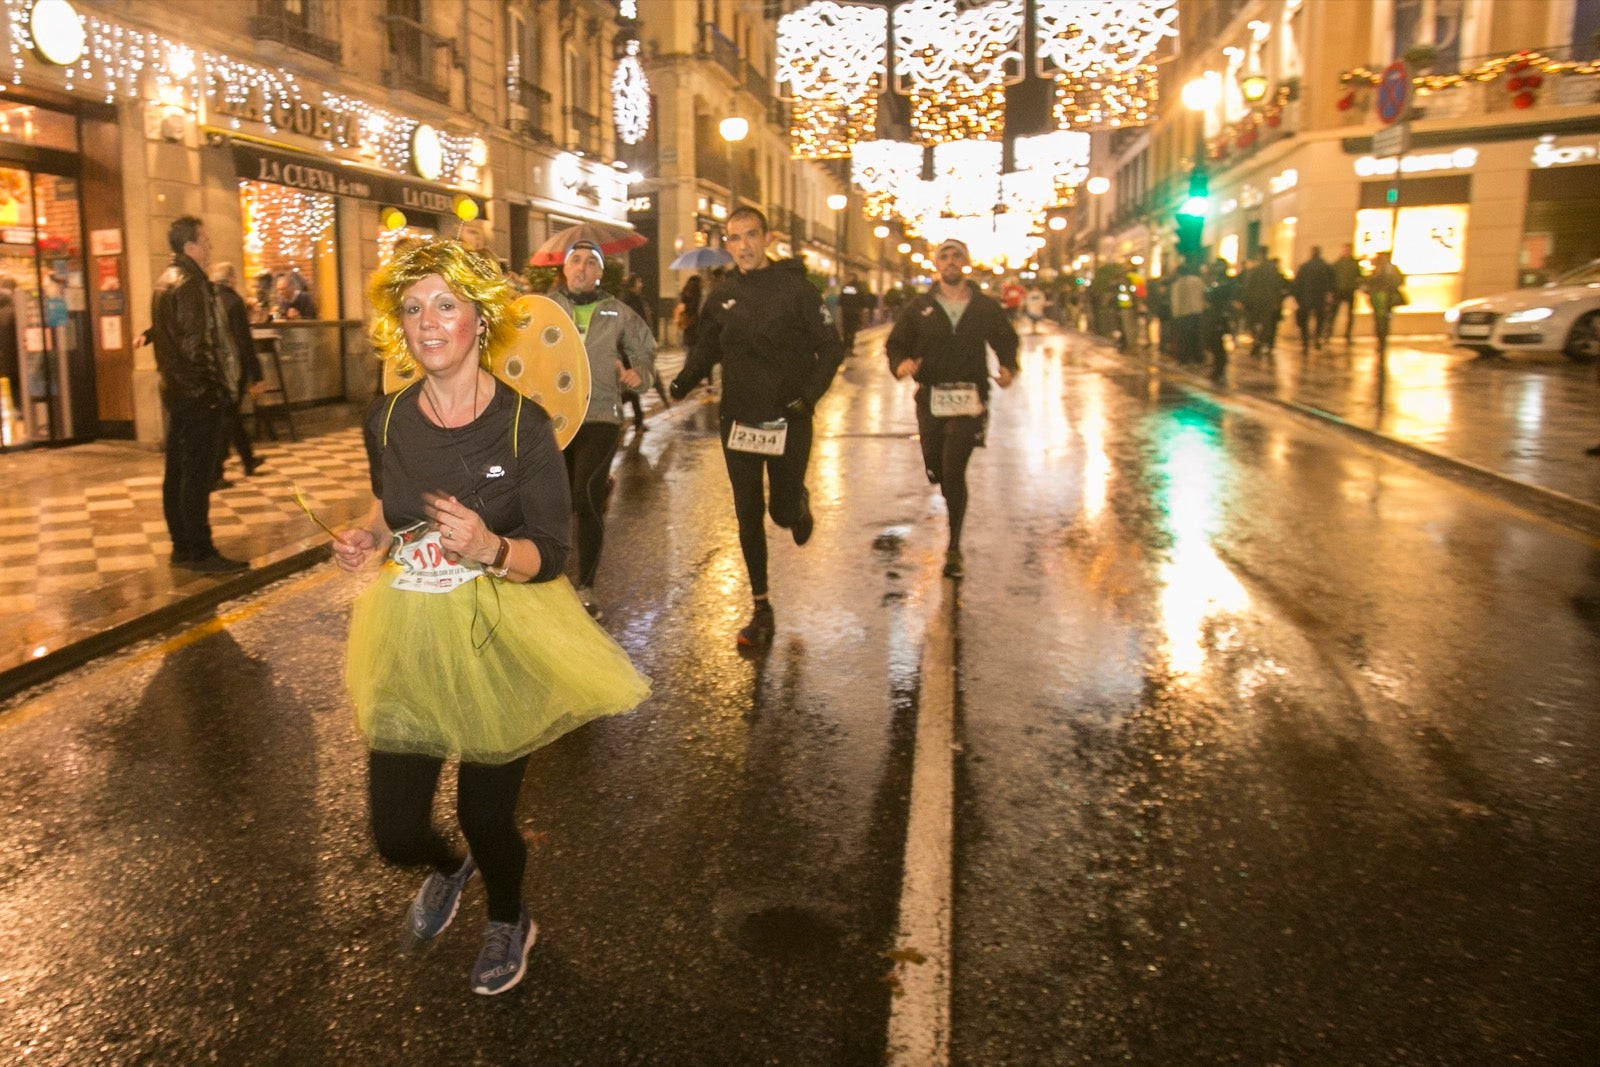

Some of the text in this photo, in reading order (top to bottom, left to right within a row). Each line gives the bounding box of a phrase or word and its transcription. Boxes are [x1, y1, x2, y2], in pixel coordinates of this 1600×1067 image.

[258, 157, 281, 181] LA
[283, 163, 337, 193] CUEVA
[402, 187, 455, 214] LA CUEV
[737, 430, 777, 445] 2334
